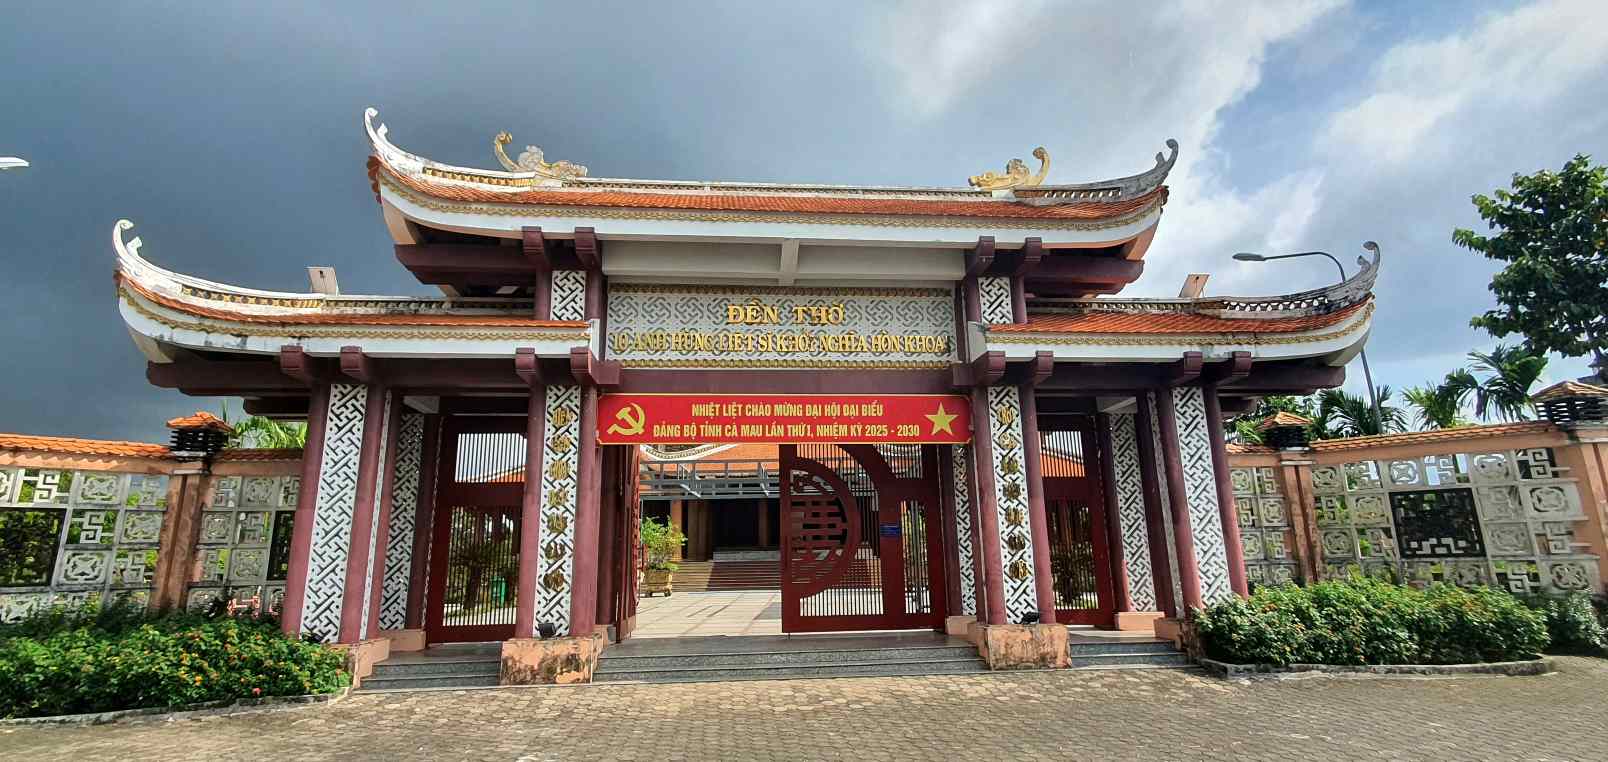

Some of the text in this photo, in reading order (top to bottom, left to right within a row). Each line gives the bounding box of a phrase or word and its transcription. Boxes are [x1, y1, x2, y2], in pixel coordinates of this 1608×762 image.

[727, 296, 845, 325] ĐỀN THỜ
[633, 333, 667, 352] ANH
[692, 400, 883, 419] NHIỆT LIỆT CHÀO MỪNG ĐẠI HỘI ĐẠI BIỂU
[653, 421, 681, 437] ĐẢNG
[684, 423, 697, 440] BỘ
[700, 421, 722, 437] TỈNH
[741, 424, 763, 437] MAU
[817, 423, 848, 439] NHIỆM
[850, 423, 862, 437] KỲ
[865, 424, 888, 437] 2025
[897, 424, 920, 437] 2030
